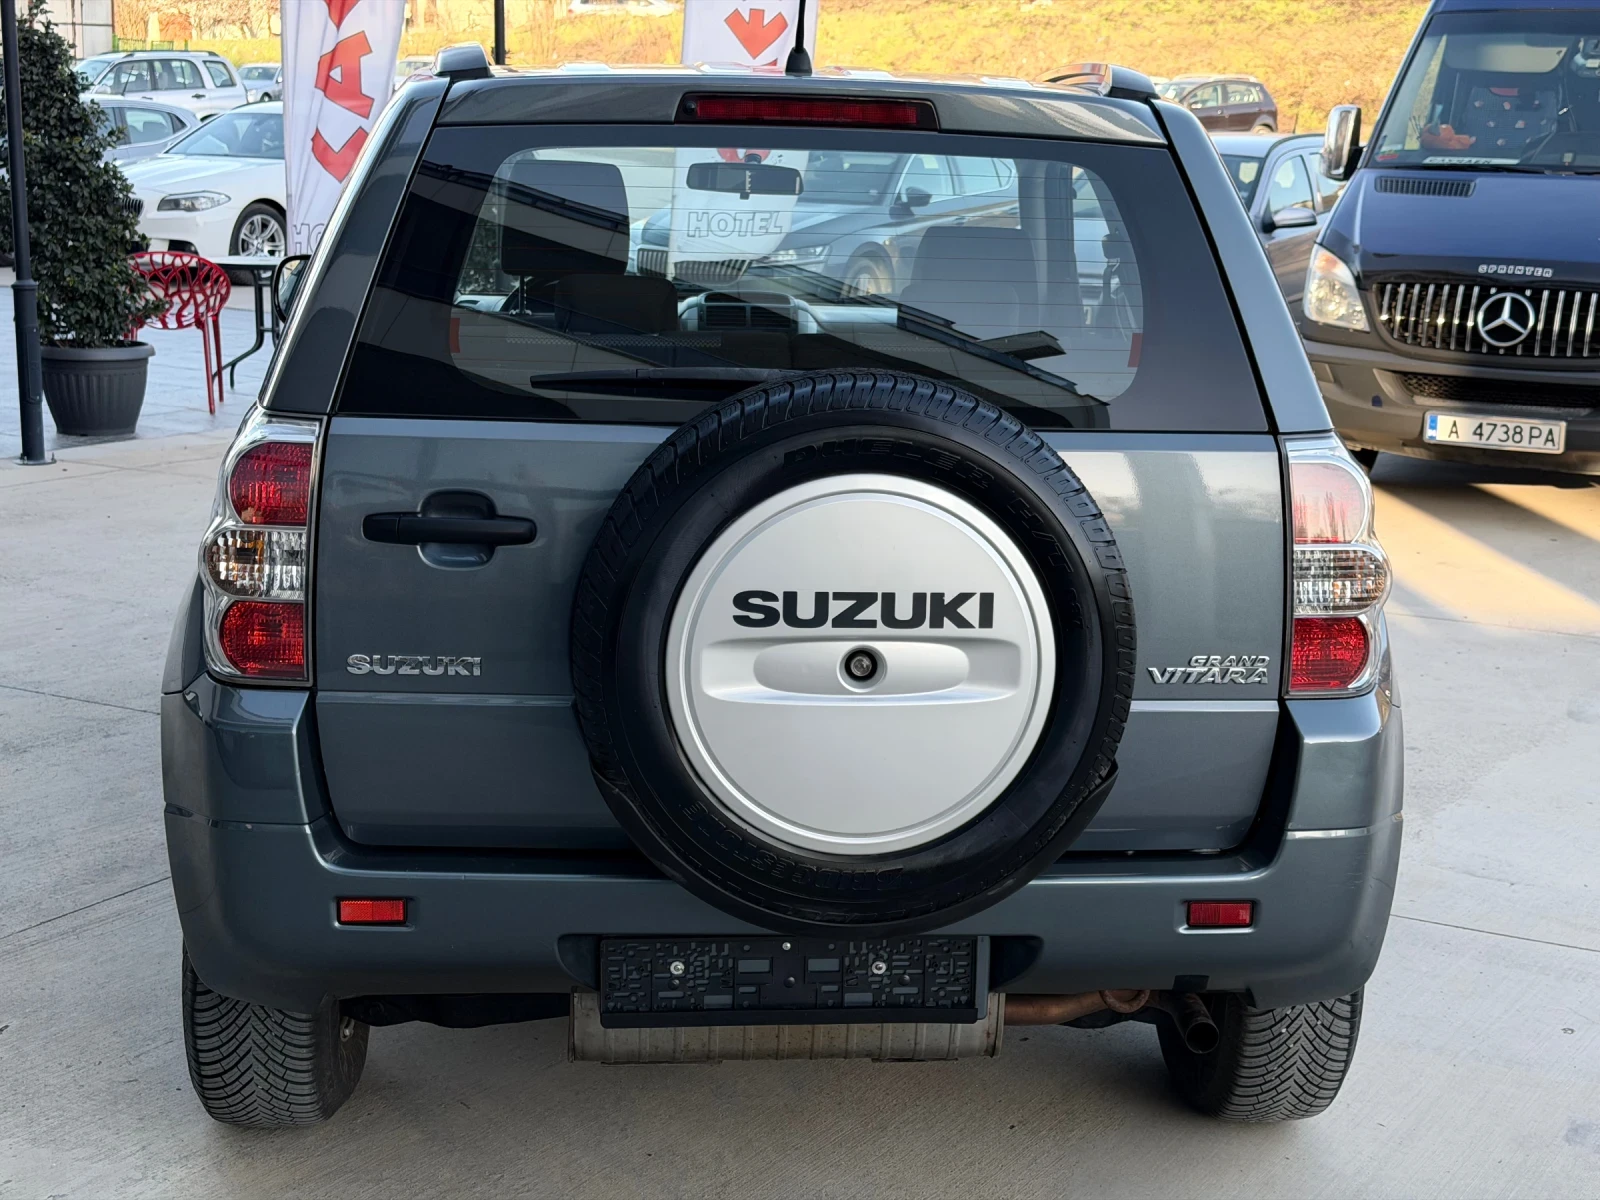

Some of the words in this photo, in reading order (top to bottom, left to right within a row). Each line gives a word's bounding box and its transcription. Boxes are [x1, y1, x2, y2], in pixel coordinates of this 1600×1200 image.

[687, 210, 784, 238] HOTEL
[1477, 263, 1554, 278] SPRINTER
[1447, 420, 1460, 439] A
[1472, 422, 1525, 444] 4738
[732, 589, 995, 629] SUZUKI
[346, 653, 482, 676] SUZUKI
[1188, 655, 1270, 667] GRAND
[1148, 667, 1268, 684] VITARA
